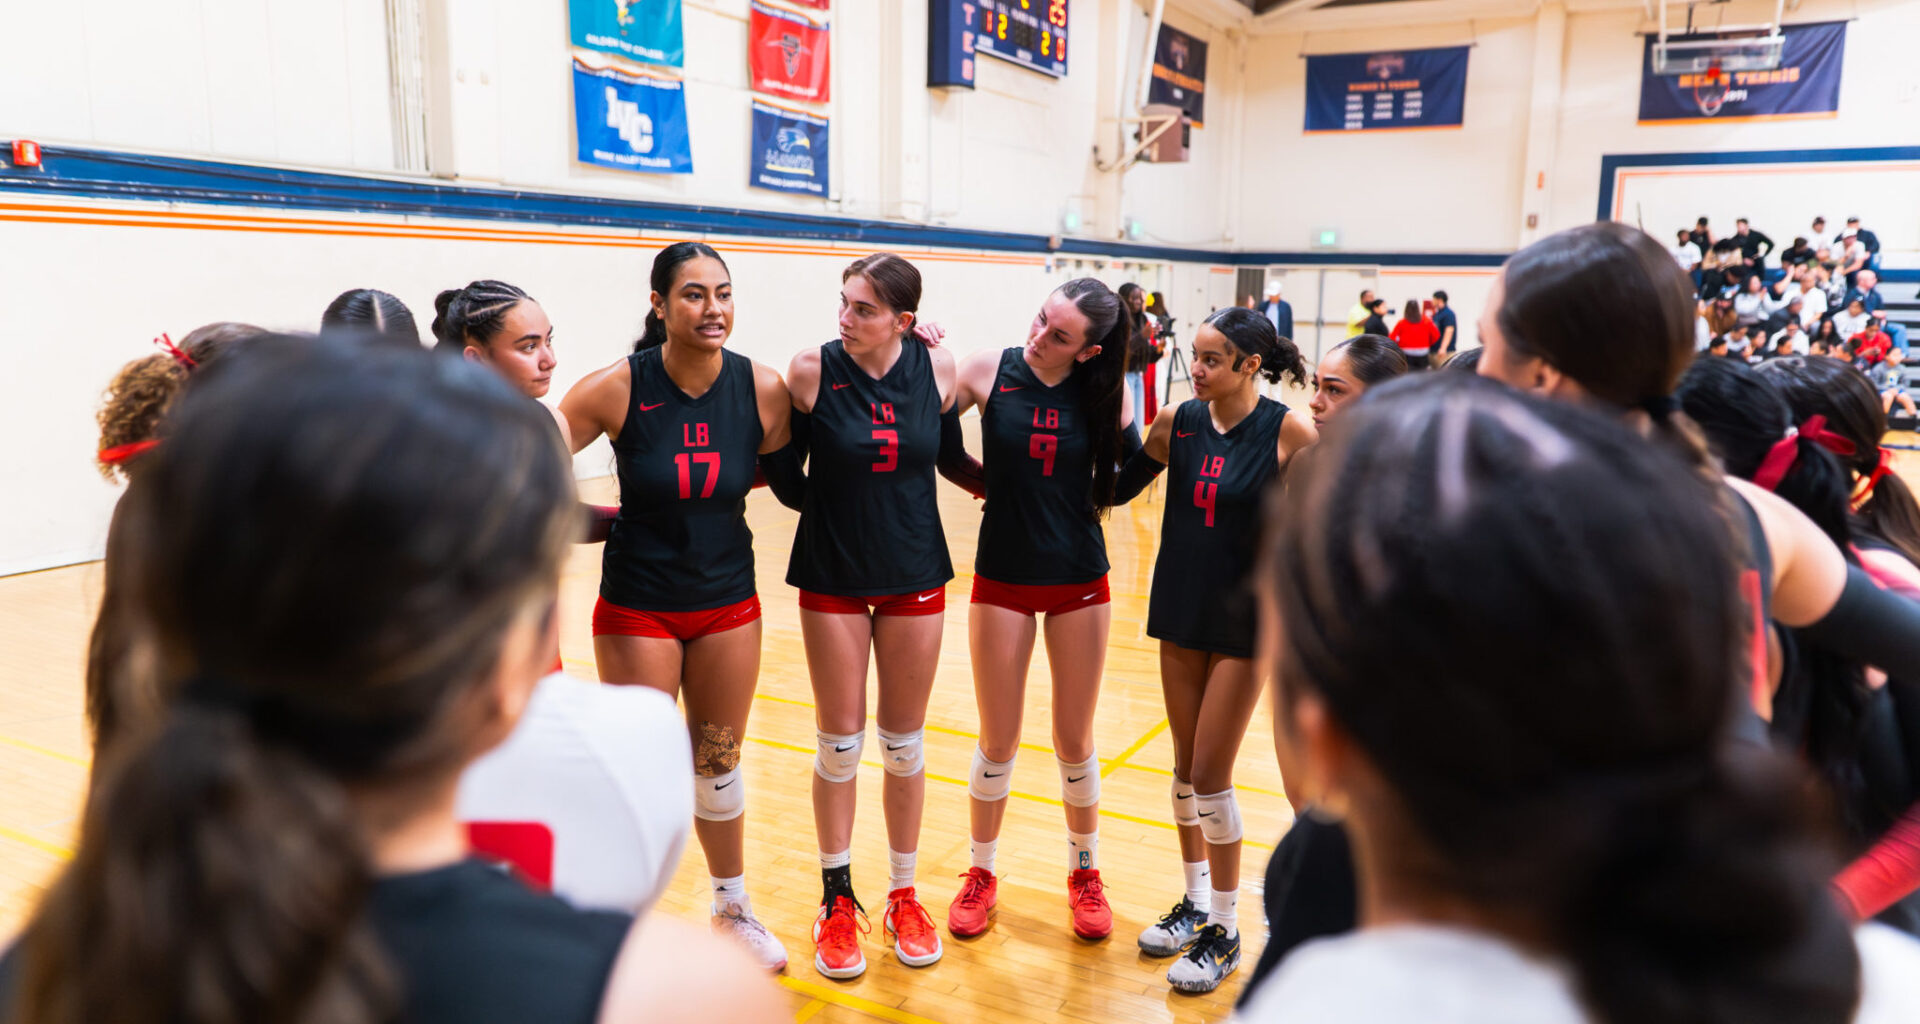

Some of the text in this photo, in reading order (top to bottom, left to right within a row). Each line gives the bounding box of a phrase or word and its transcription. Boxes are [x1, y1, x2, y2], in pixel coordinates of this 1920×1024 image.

[997, 13, 1008, 40] 2
[1040, 30, 1051, 57] 2
[1056, 37, 1065, 61] 0
[1735, 67, 1800, 86] TENNIS
[871, 402, 896, 425] LB
[1032, 406, 1059, 429] LB
[684, 422, 709, 447] LB
[871, 429, 899, 473] 3
[1029, 433, 1058, 477] 9
[1200, 454, 1225, 478] LB
[674, 452, 721, 500] 17
[1193, 480, 1218, 528] 4
